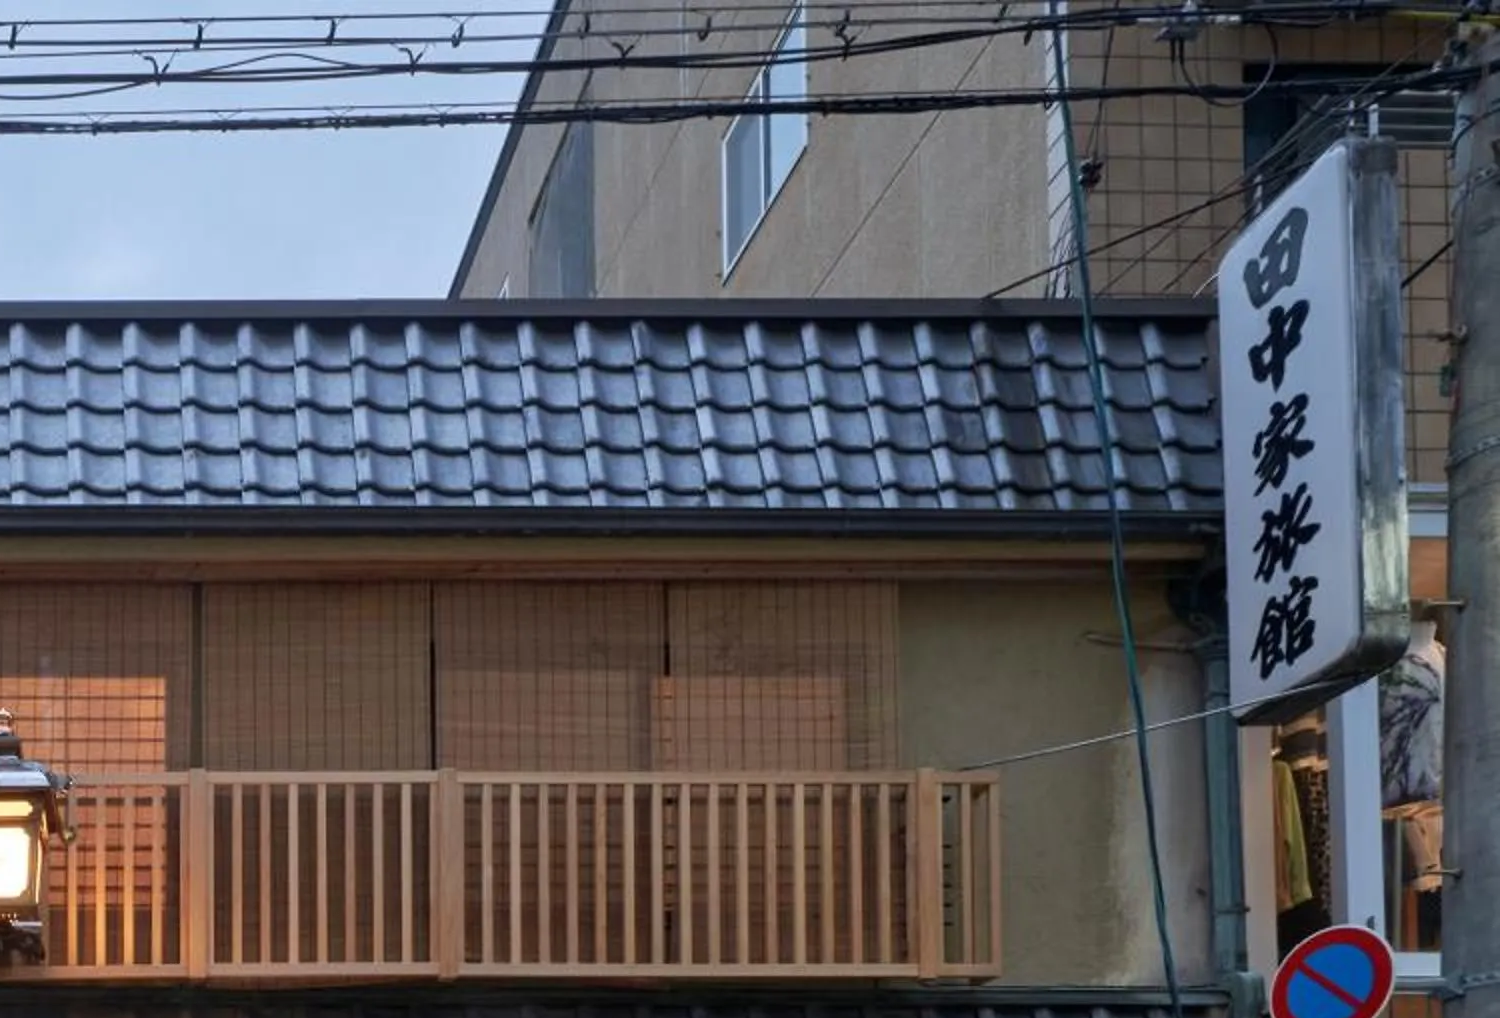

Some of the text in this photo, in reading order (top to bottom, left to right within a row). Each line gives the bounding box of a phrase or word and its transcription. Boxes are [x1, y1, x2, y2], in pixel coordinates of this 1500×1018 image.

[1243, 206, 1321, 681] 田中家旅館
